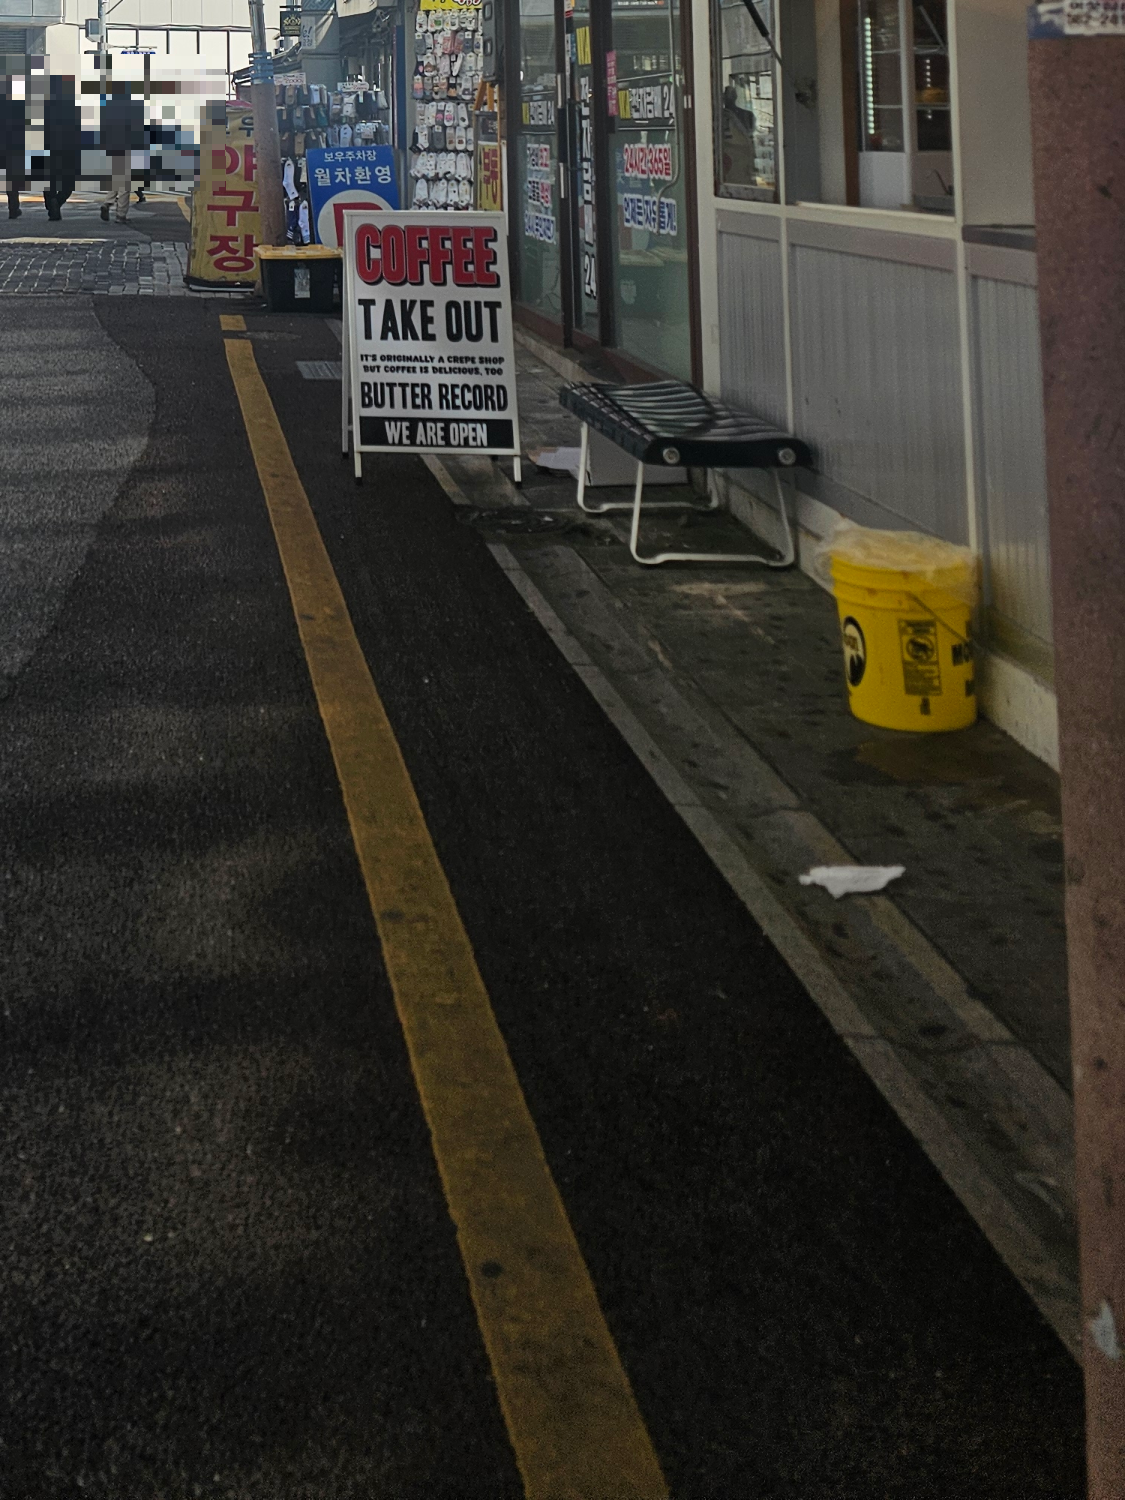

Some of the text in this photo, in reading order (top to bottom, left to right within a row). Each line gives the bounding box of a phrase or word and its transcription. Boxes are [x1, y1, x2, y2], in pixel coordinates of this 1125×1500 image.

[324, 150, 377, 162] 보우주차장
[314, 165, 392, 186] 월차환영
[355, 223, 501, 288] COFFEE
[358, 299, 502, 343] TAKE OUT
[360, 354, 505, 365] IT'S ORIGINALLY A CREPE SHOP
[363, 364, 381, 373] BUT
[383, 365, 417, 374] COFFEE
[419, 365, 429, 374] IS
[485, 367, 503, 376] TOO
[360, 381, 509, 412] BUTTER RECORD
[385, 420, 488, 447] WE ARE OPEN
